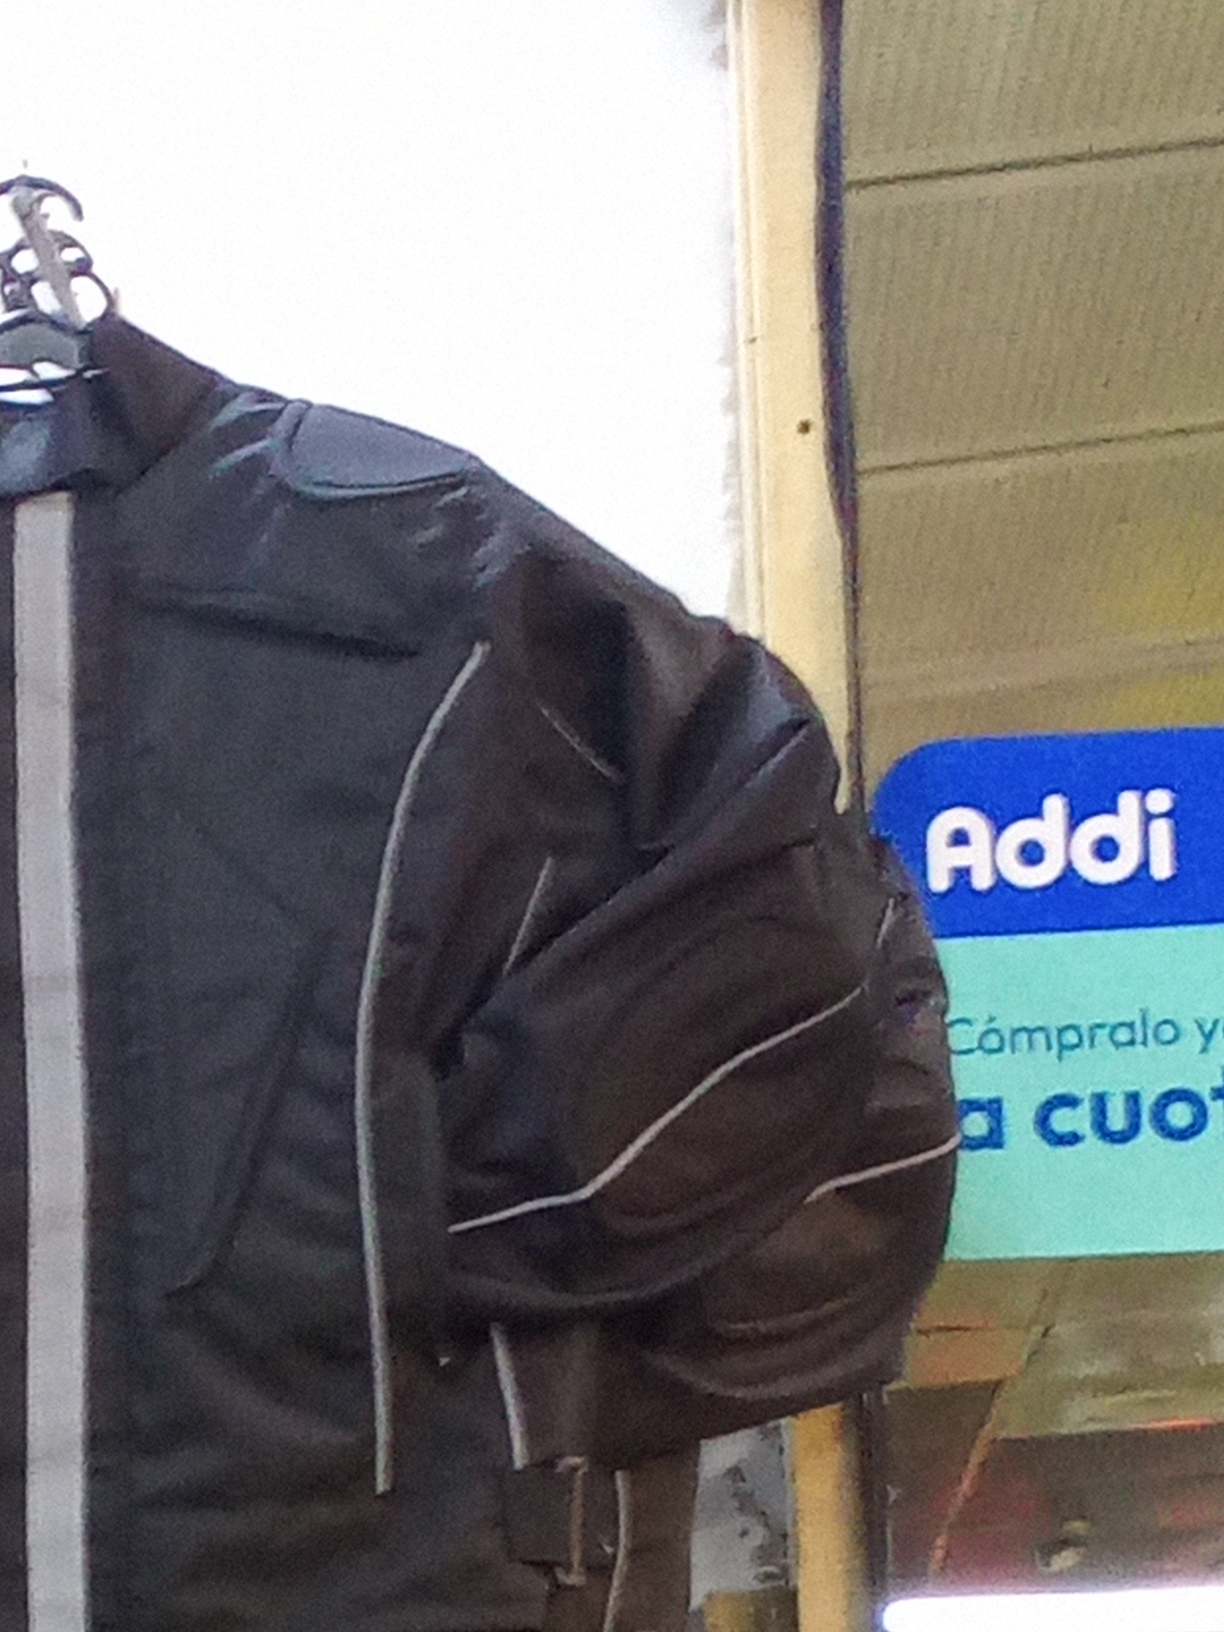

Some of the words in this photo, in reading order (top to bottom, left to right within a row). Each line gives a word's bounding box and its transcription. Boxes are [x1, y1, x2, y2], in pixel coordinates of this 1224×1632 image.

[926, 787, 1177, 893] Addi
[948, 1008, 1180, 1063] Cómpralo
[1194, 1018, 1224, 1054] y
[958, 1096, 1004, 1150] a
